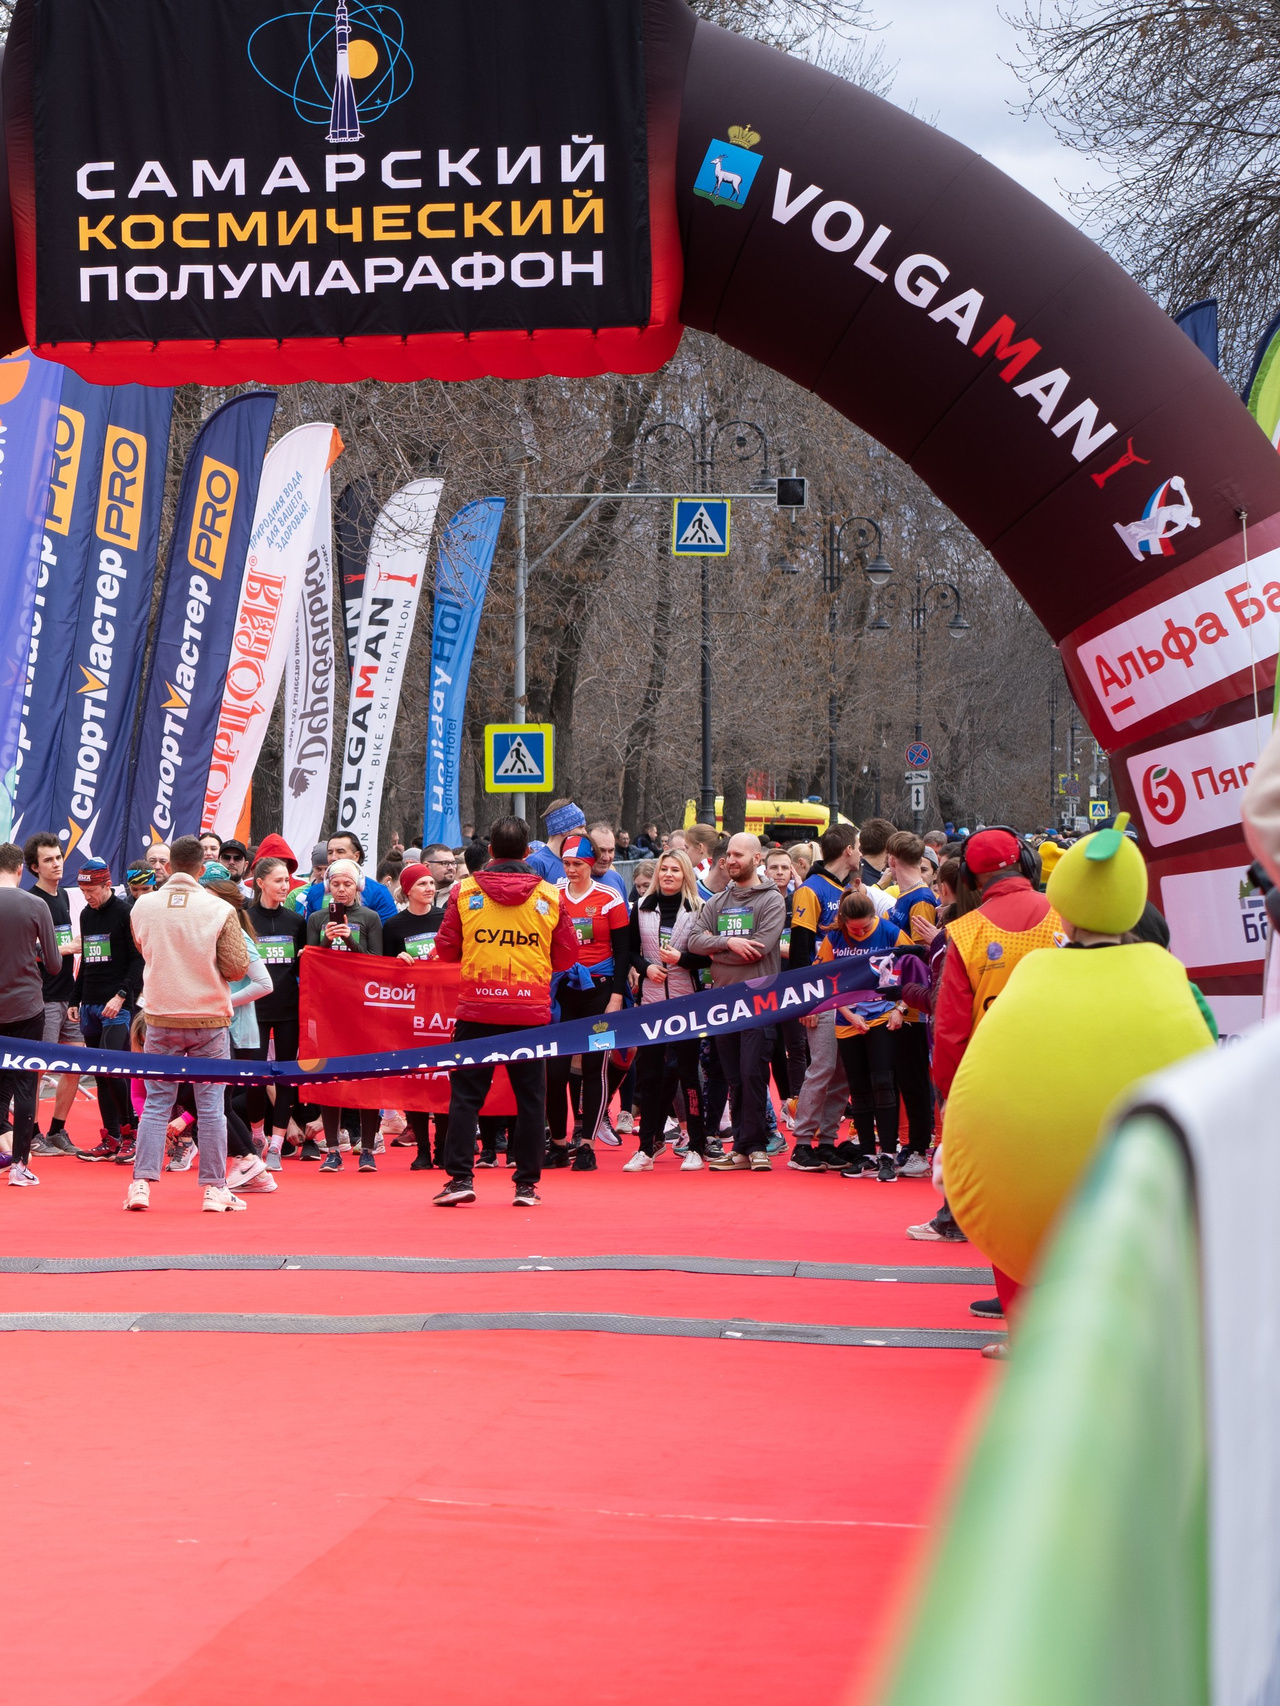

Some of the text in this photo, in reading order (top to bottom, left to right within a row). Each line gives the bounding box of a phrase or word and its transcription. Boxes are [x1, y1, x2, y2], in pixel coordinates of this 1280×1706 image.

[76, 134, 605, 201] САМАРСКИЙ
[78, 189, 605, 251] КОСМИЧЕСКИЙ
[80, 250, 604, 302] ПОЛУМАРАФОН
[770, 166, 1118, 463] VOLGAMAN
[104, 436, 140, 542] PRO
[193, 468, 234, 571] PRO
[249, 470, 303, 551] ПРИРОДНАЯ ВОДА
[265, 490, 303, 549] ДЛЯ ВАШЕГО
[274, 500, 311, 553] ЗДОРОВЬЯ!
[1094, 582, 1280, 712] Альфа Ба
[341, 597, 395, 828] OLGAMAN
[371, 733, 385, 766] BIKE
[378, 695, 390, 720] SKI
[384, 600, 413, 682] TRIATHLON
[432, 664, 453, 814] Holiday
[443, 718, 457, 816] Samara Hotel
[88, 945, 102, 956] 330
[266, 946, 285, 958] 355
[474, 929, 540, 947] СУДЬЯ
[727, 918, 742, 929] 316
[364, 981, 416, 1001] Свой
[640, 979, 825, 1040] VOLGAMAN
[413, 1016, 425, 1029] в
